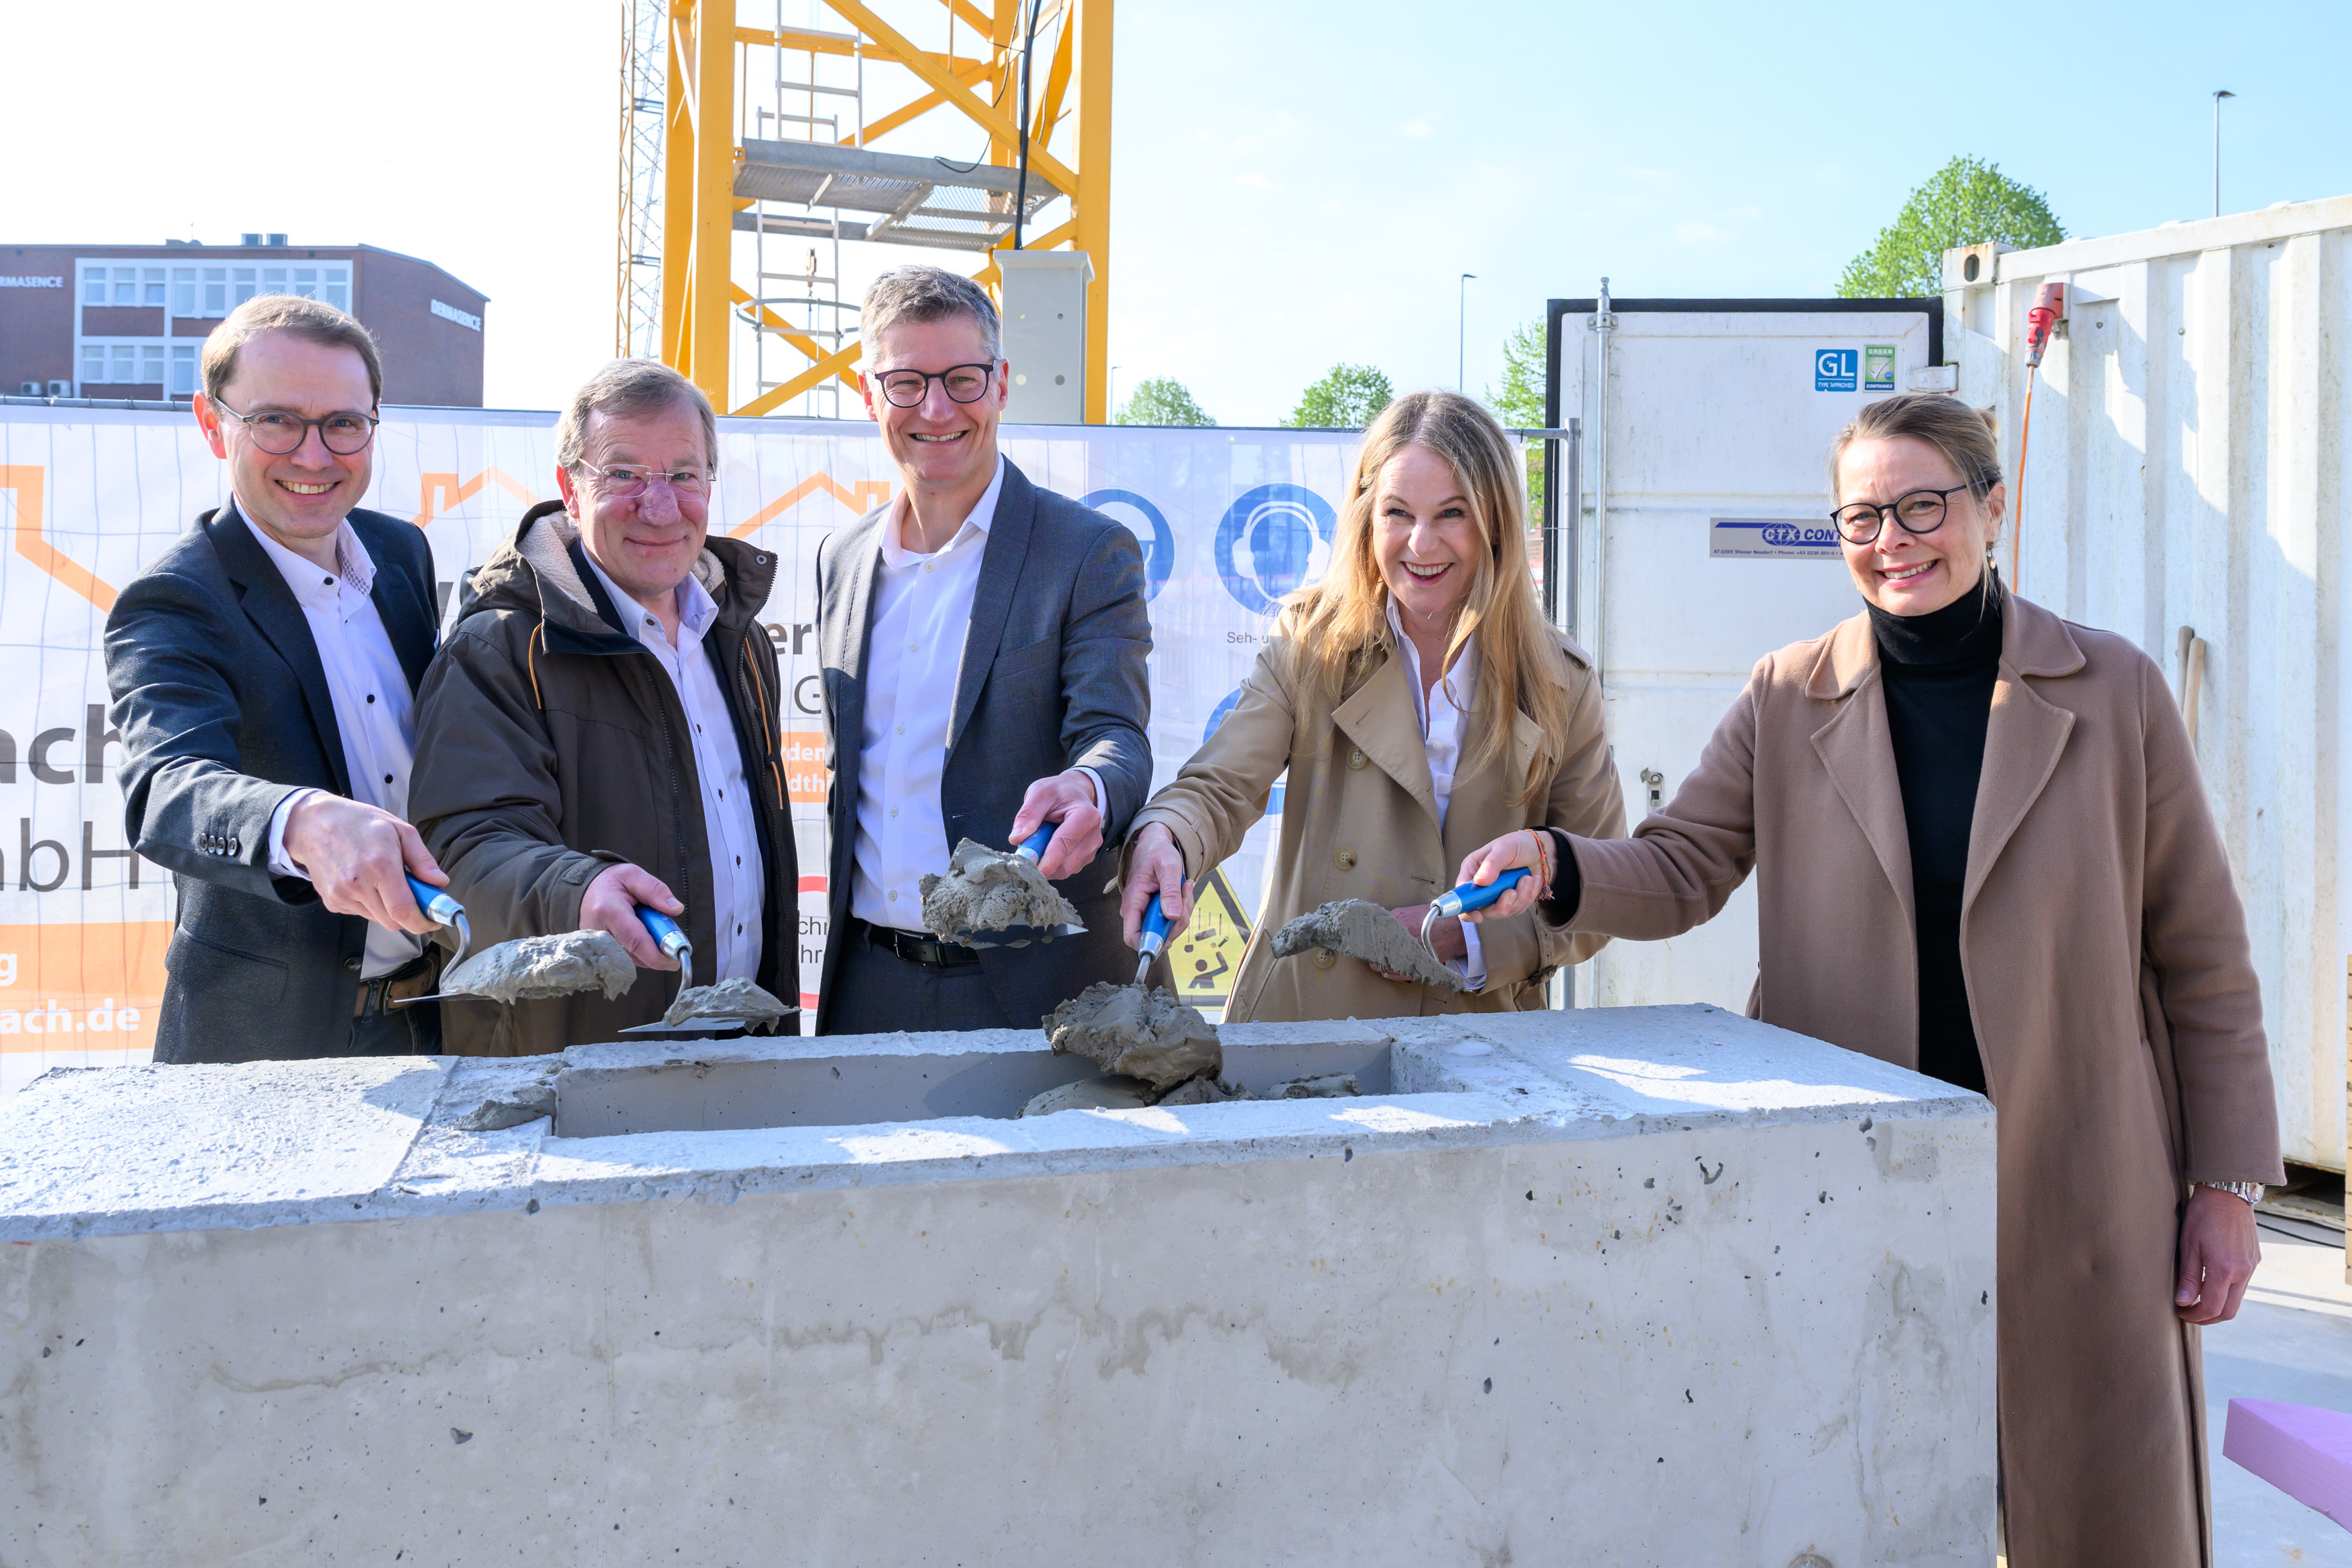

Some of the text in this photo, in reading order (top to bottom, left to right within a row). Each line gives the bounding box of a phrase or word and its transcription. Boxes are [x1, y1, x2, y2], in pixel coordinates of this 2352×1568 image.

[1818, 353, 1854, 377] GL
[1765, 529, 1797, 540] CTX
[1227, 632, 1256, 643] Seh-
